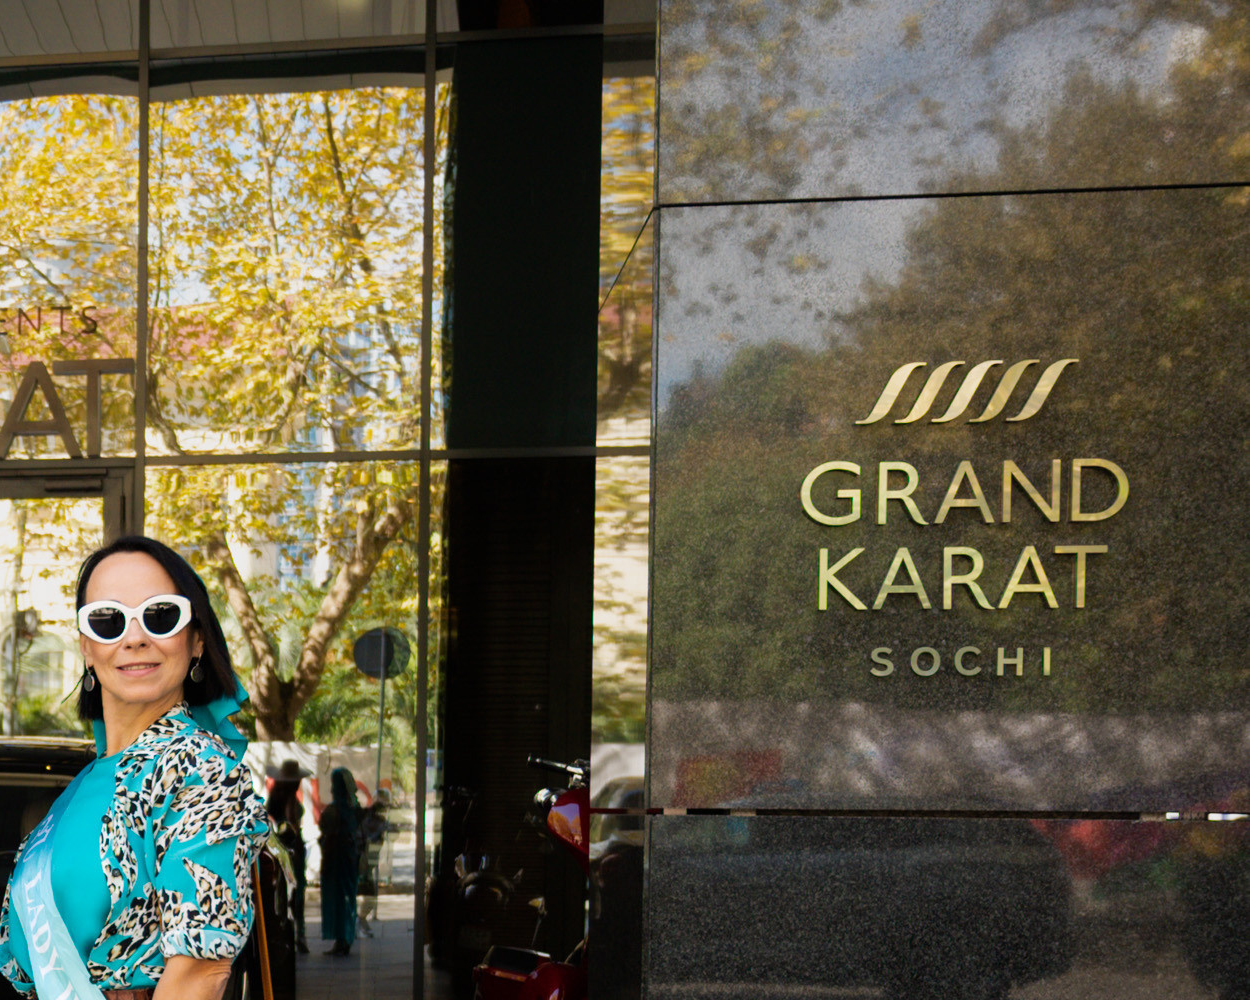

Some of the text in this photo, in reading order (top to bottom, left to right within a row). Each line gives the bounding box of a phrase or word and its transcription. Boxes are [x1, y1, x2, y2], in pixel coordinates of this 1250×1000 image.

[800, 458, 1130, 526] GRAND
[818, 544, 1108, 610] KARAT
[869, 646, 1051, 677] SOCHI
[24, 868, 65, 979] LADY
